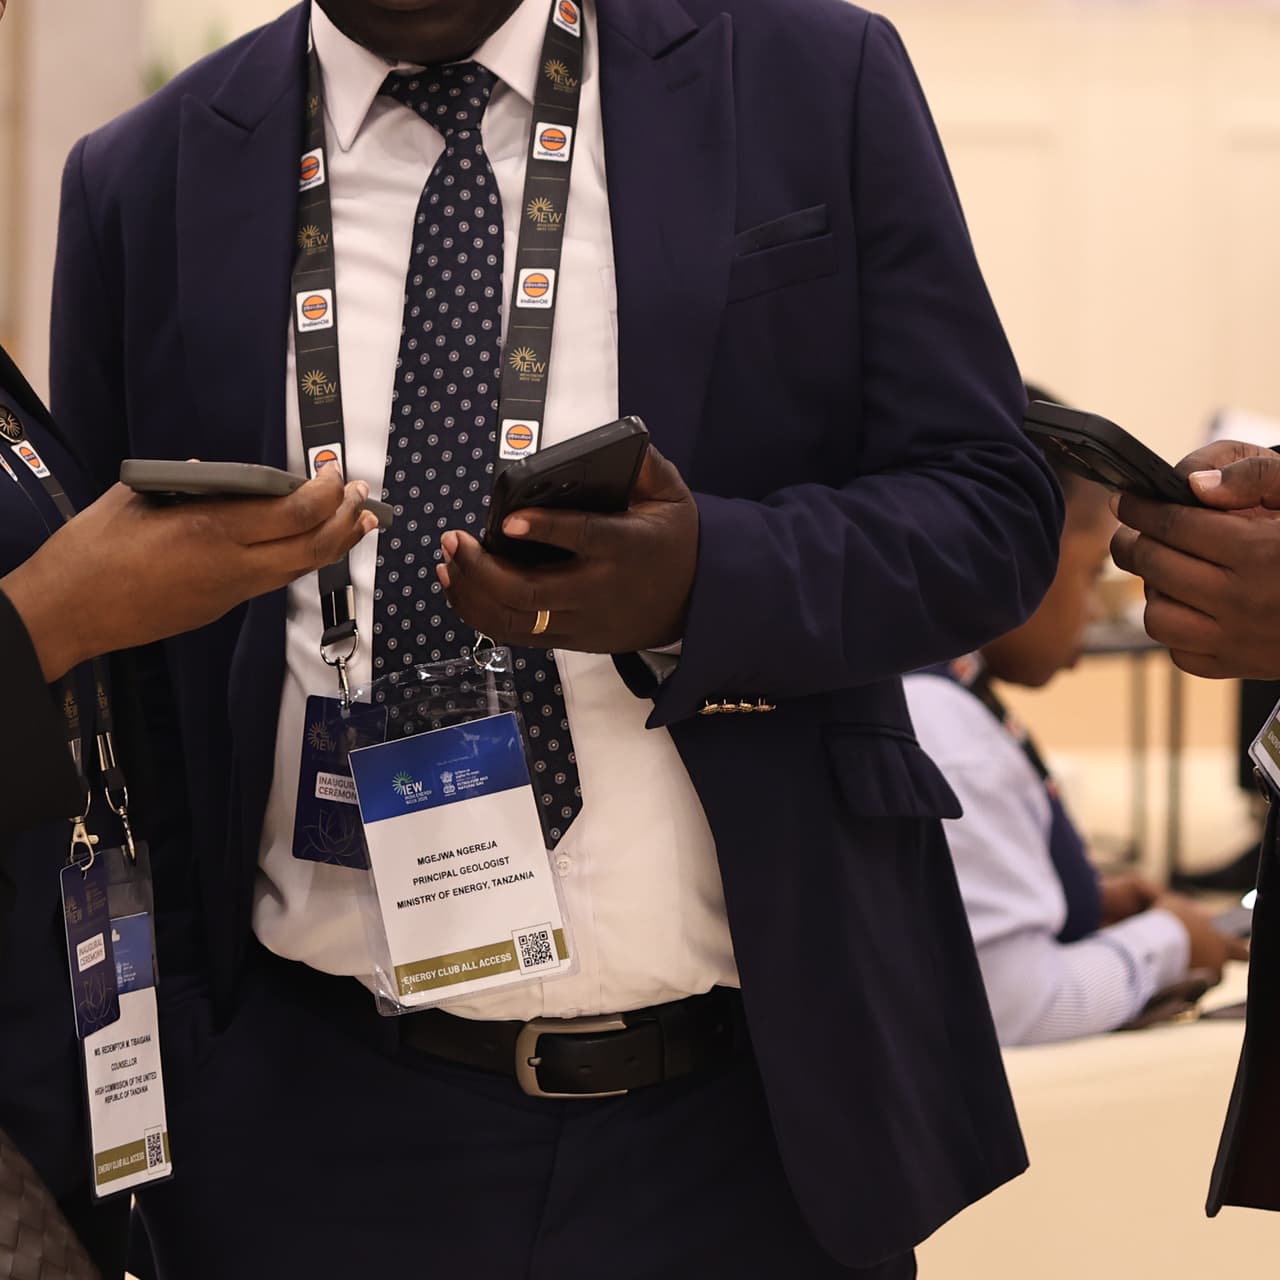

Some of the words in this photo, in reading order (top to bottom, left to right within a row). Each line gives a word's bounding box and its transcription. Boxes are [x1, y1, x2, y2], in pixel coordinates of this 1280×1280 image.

[318, 776, 355, 790] INAUGUR
[318, 786, 357, 800] CEREMON
[402, 781, 423, 796] IEW
[417, 850, 455, 866] MGEJWA
[456, 840, 498, 856] NGEREJA
[412, 869, 458, 886] PRINCIPAL
[459, 856, 510, 875] GEOLOGIST
[396, 893, 437, 910] MINISTRY
[438, 889, 451, 900] OF
[491, 870, 535, 887] TANZANIA
[403, 969, 437, 985] ENERGY
[437, 965, 461, 977] CLUB
[461, 961, 478, 972] ALL
[479, 952, 513, 968] ACCESS
